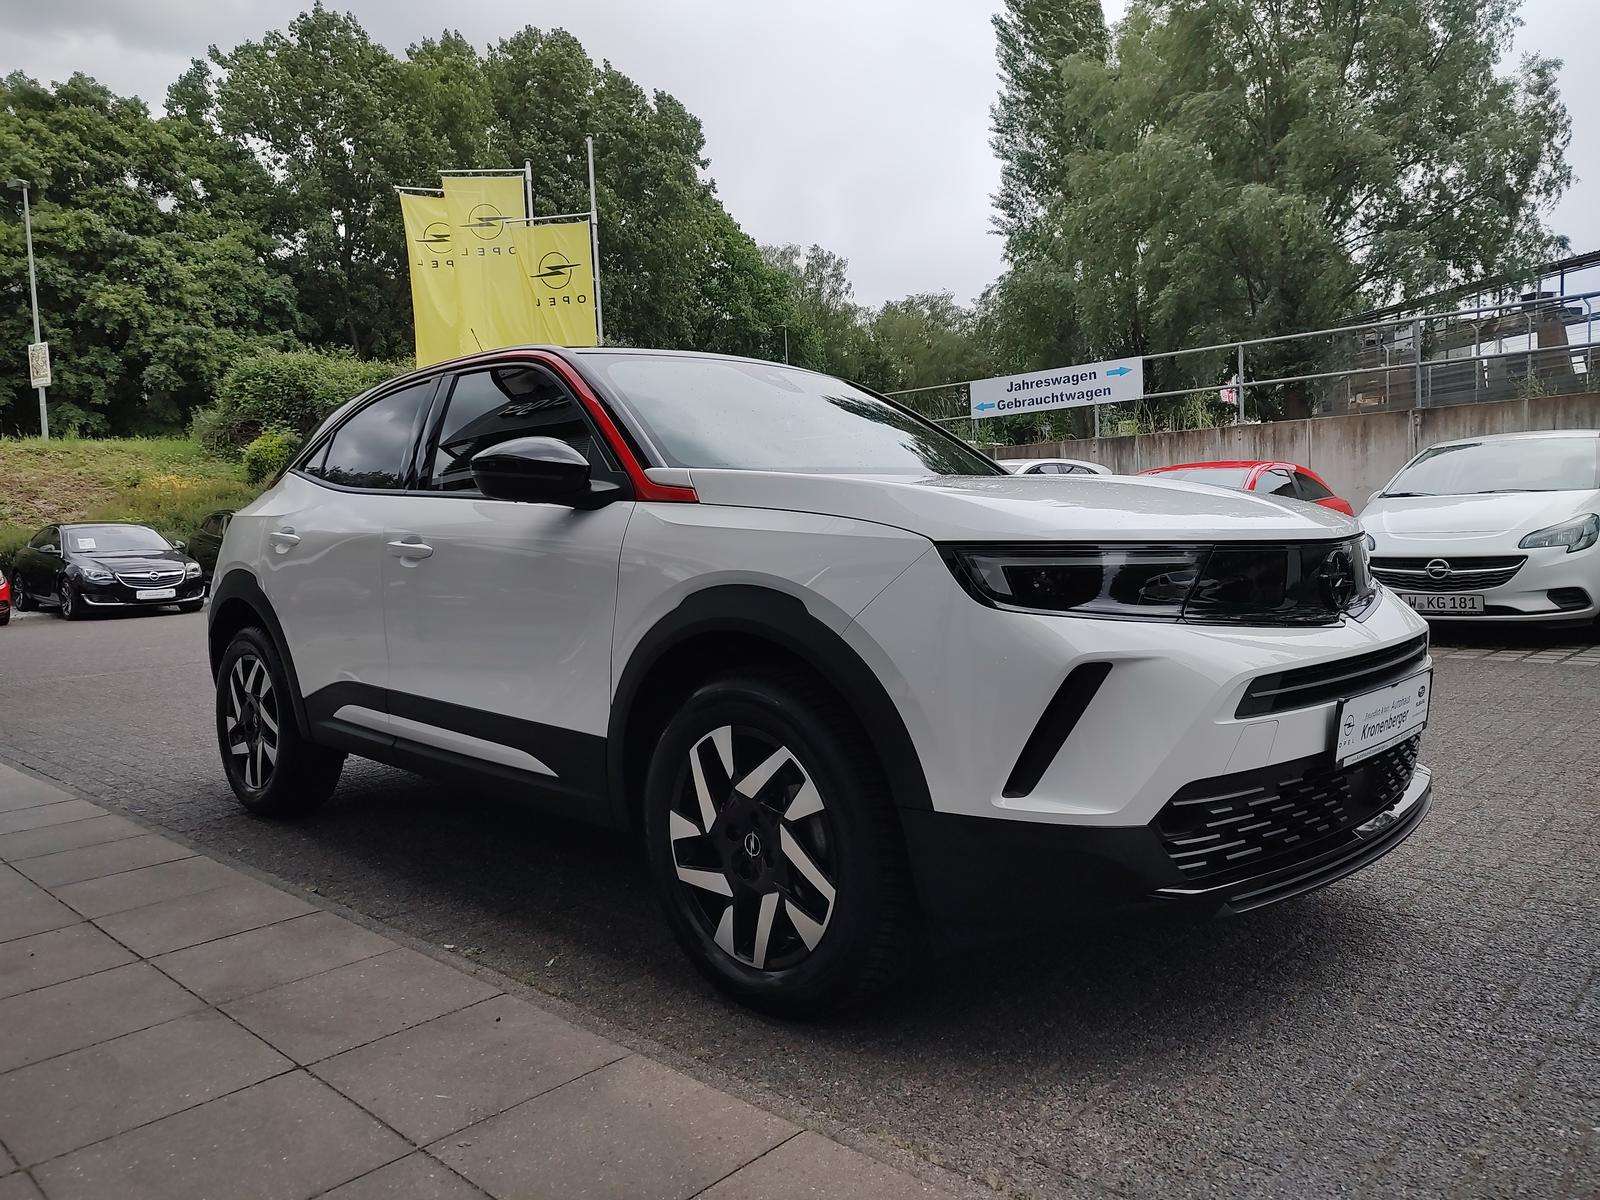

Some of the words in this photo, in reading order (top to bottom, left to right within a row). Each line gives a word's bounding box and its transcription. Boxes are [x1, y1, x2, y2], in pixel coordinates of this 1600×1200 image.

[1006, 370, 1097, 393] Jahreswagen
[997, 387, 1112, 411] Gebrauchtwagen
[1426, 596, 1446, 609] KG
[1449, 596, 1477, 609] 181
[1360, 709, 1410, 741] Kronenberger
